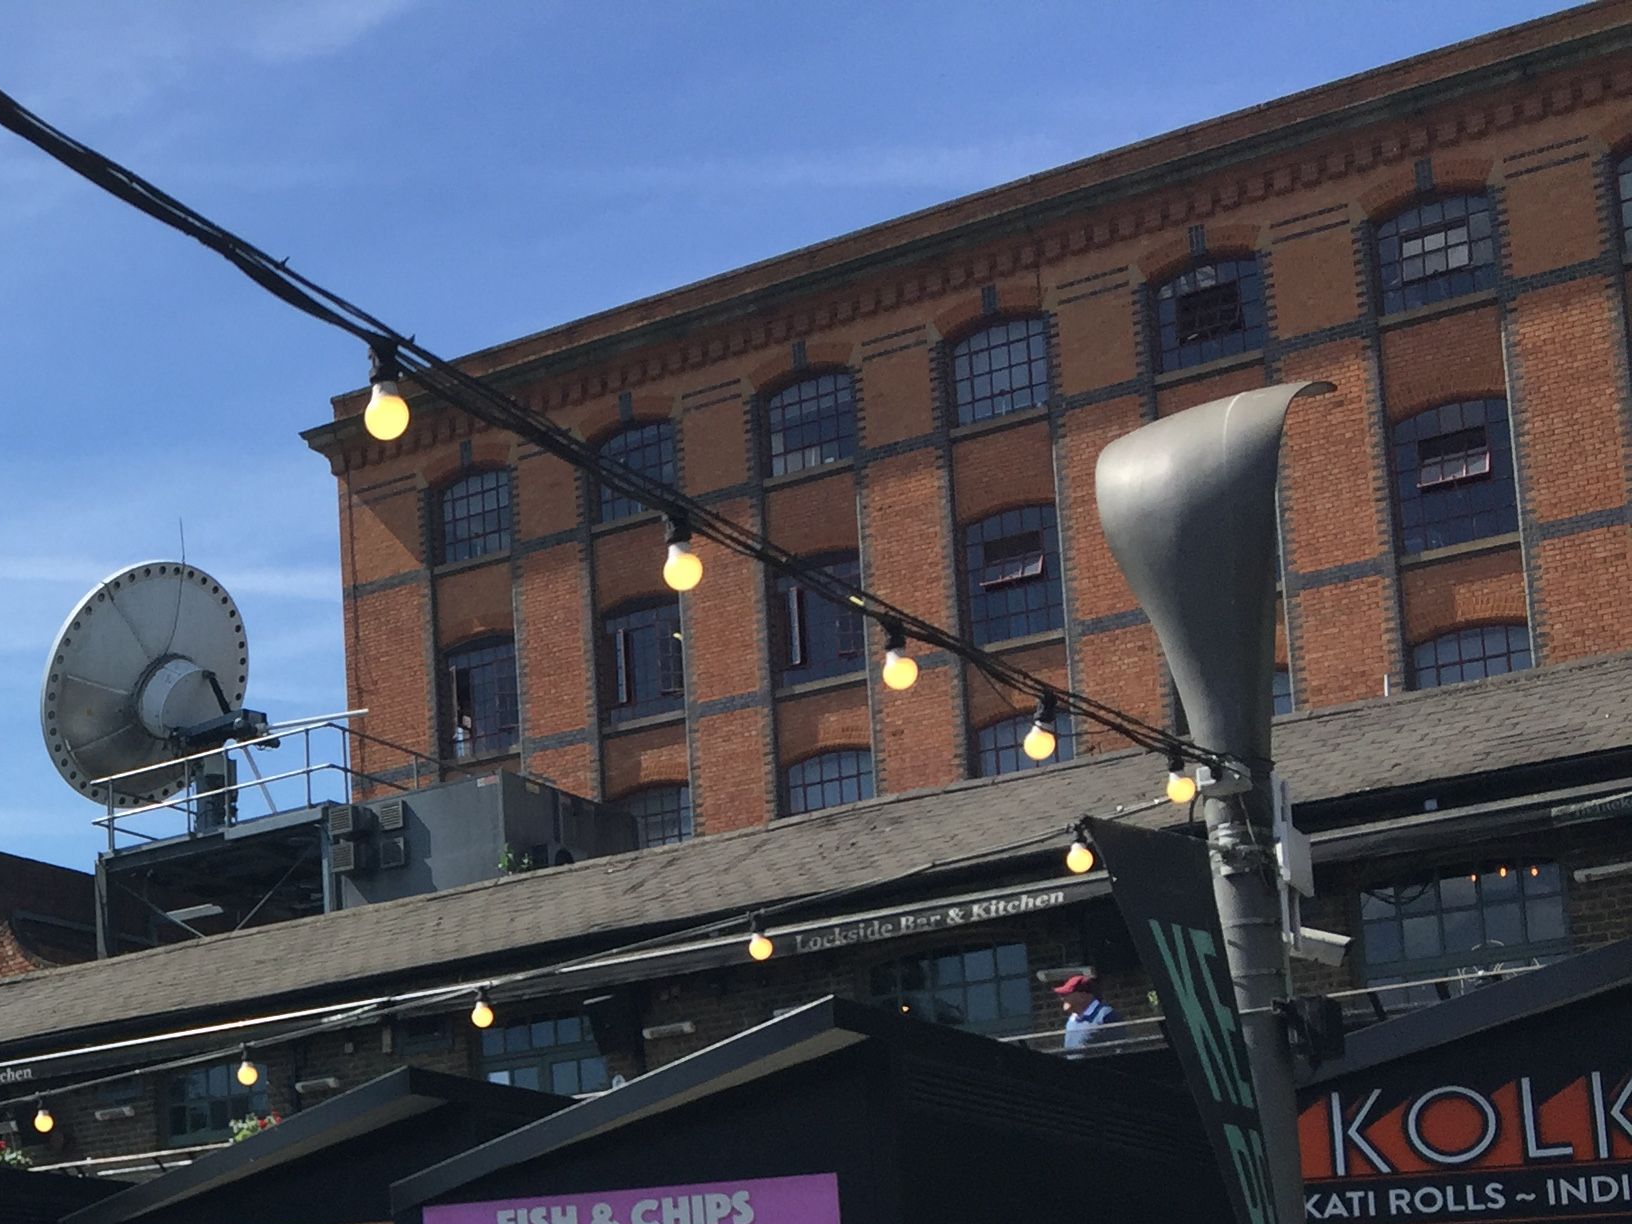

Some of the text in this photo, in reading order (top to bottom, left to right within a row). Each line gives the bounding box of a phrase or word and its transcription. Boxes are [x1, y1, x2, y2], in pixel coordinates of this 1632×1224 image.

[795, 919, 893, 952] Lockside
[946, 907, 966, 925] &
[970, 890, 1065, 922] Kitchen
[1305, 1190, 1377, 1220] KATI
[1388, 1182, 1507, 1216] ROLLS
